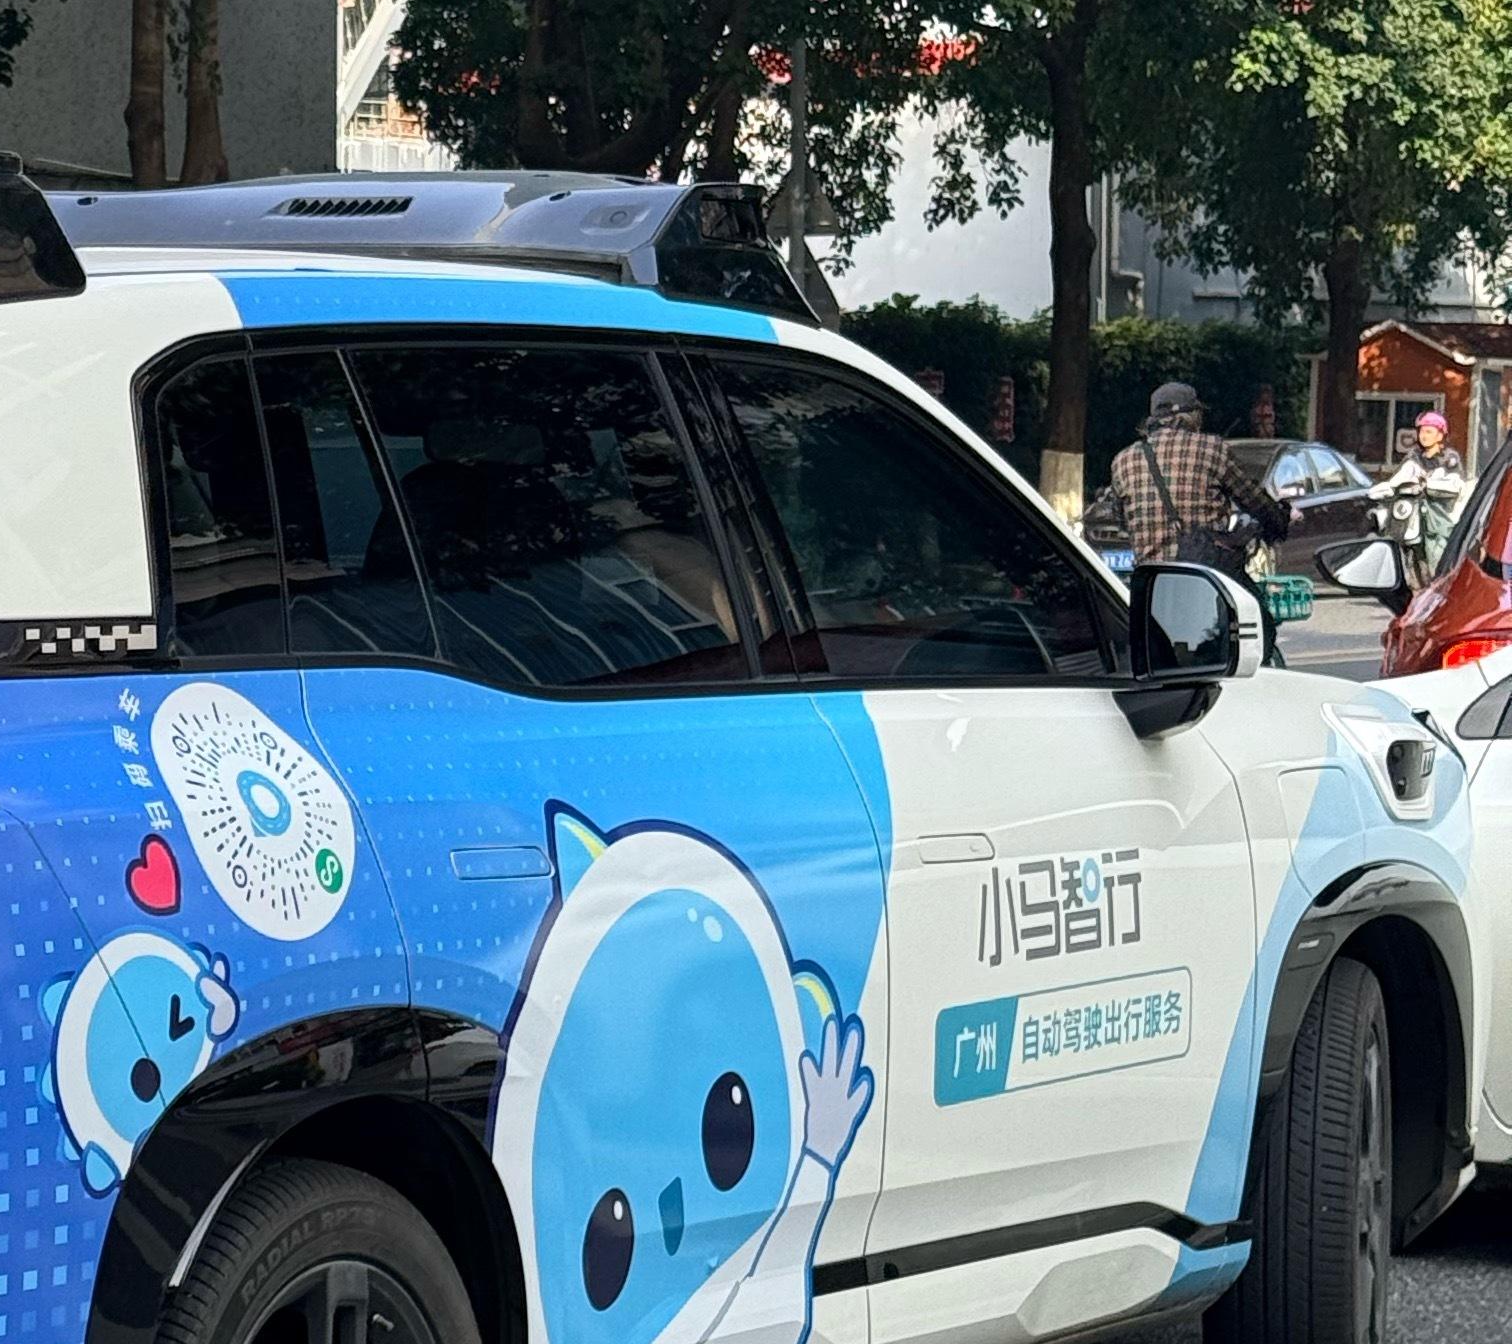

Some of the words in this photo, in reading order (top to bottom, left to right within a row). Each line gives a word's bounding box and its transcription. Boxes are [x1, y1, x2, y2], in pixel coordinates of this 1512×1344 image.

[112, 687, 173, 831] 扫码乘车
[978, 848, 1142, 968] 小马智行
[953, 1022, 997, 1079] 广州
[1021, 990, 1183, 1065] 自动驾驶出行服务
[239, 1221, 315, 1306] RADIAL
